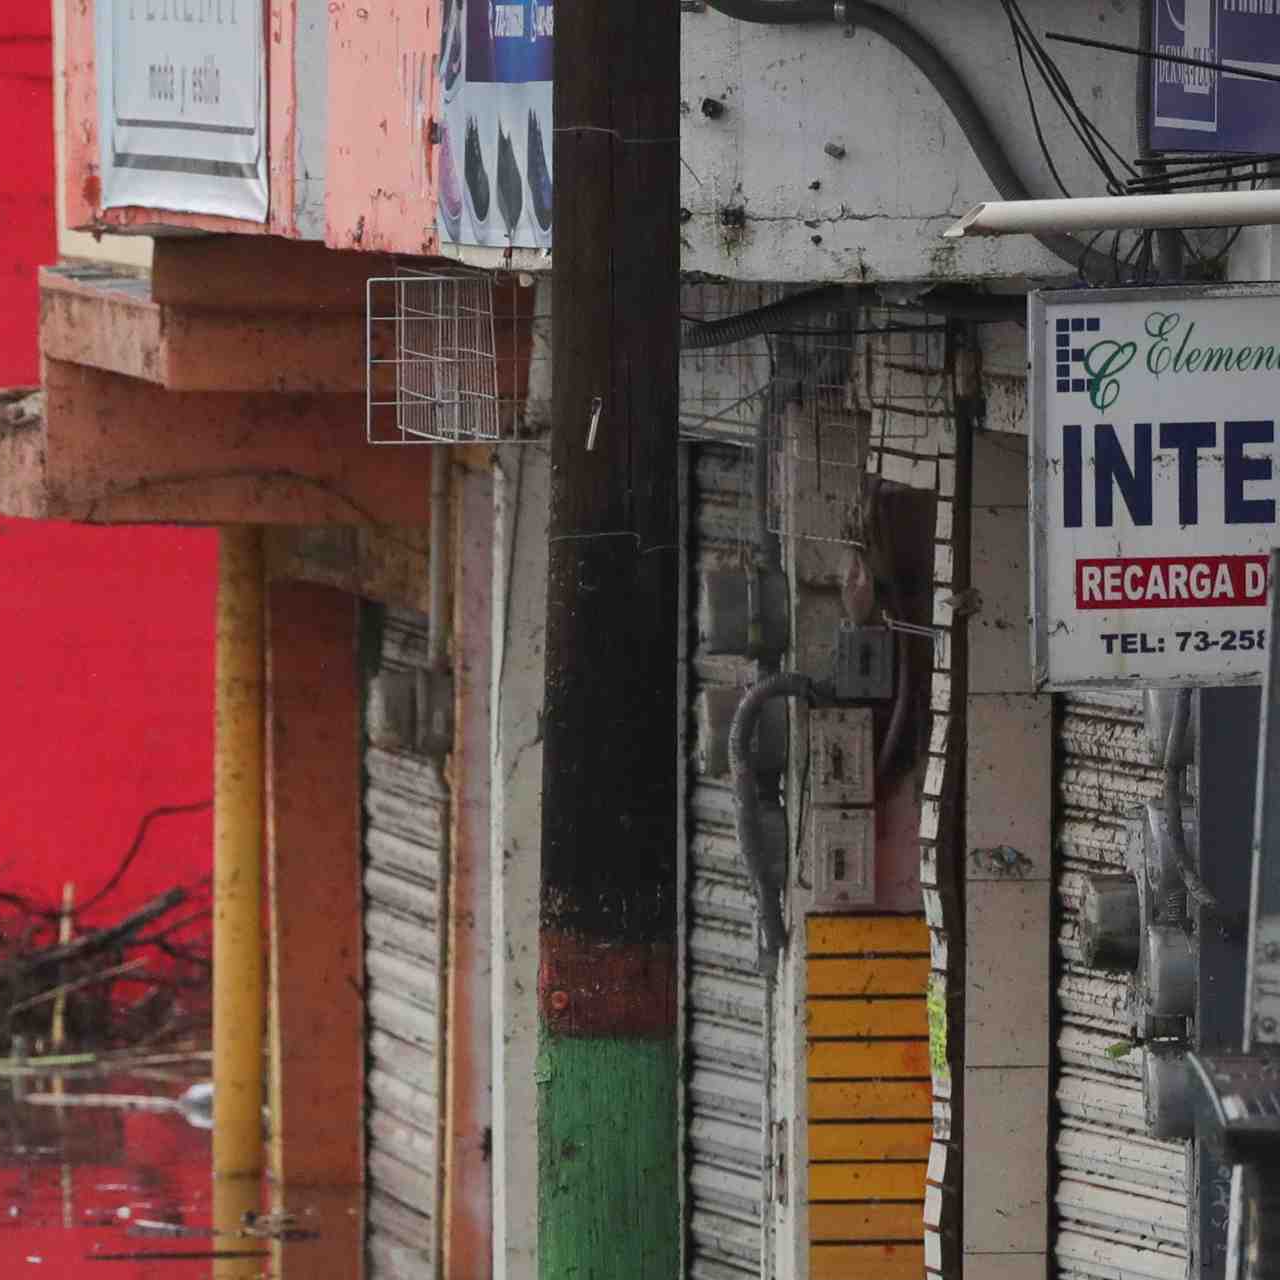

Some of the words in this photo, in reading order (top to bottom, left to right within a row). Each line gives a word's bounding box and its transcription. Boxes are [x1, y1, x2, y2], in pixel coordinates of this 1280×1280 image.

[1062, 420, 1277, 528] INTE
[1082, 563, 1235, 602] RECARGA
[1101, 633, 1165, 655] TEL:
